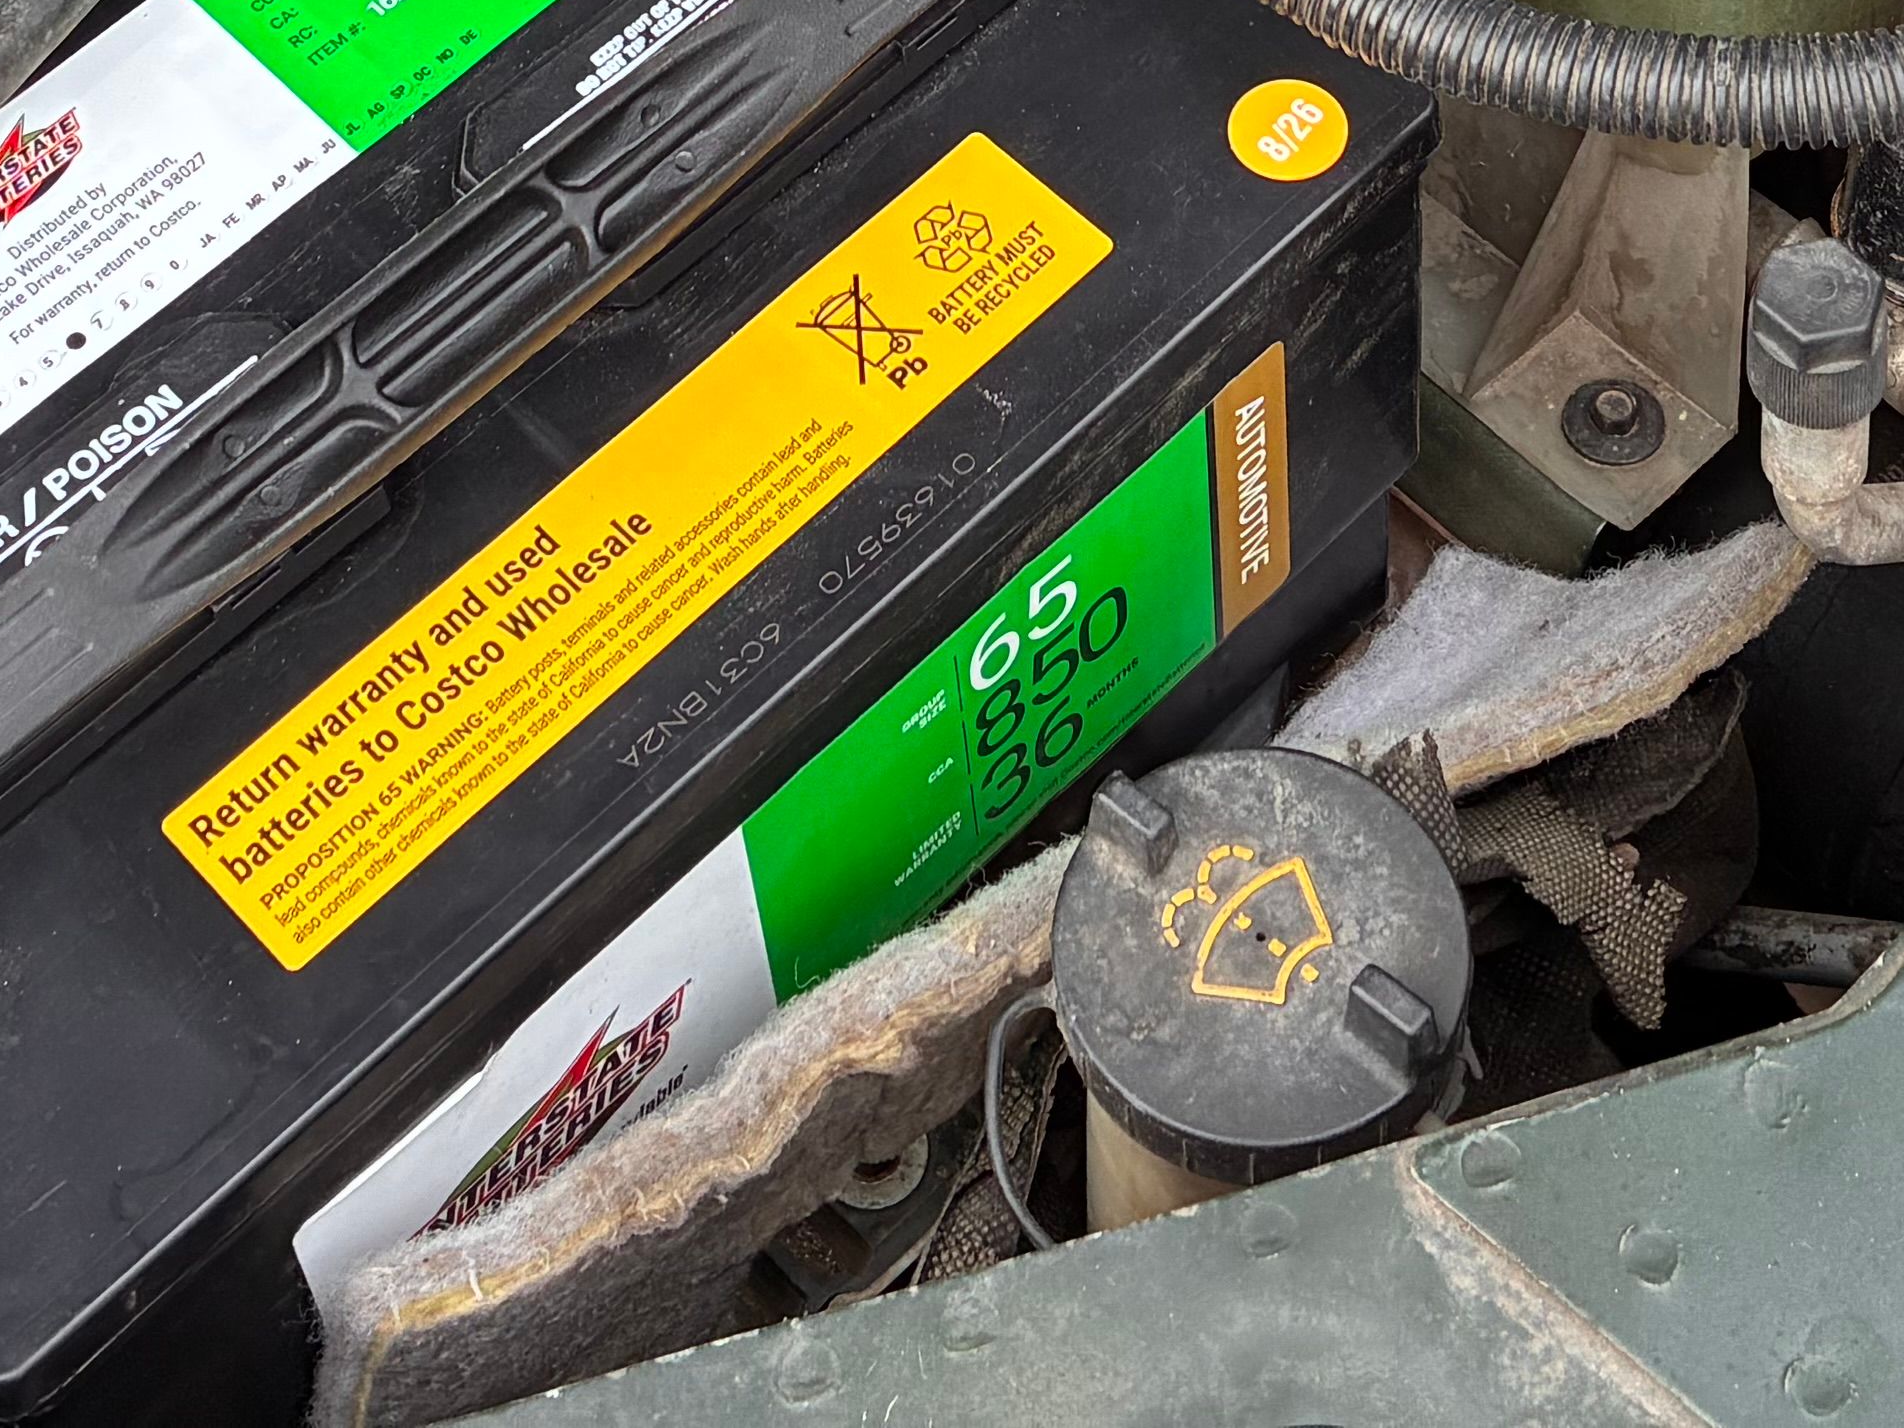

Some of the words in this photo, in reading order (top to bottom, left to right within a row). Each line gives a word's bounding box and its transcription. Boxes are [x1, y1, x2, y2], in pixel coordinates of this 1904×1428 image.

[269, 7, 299, 30] CA:
[287, 25, 318, 48] RC:
[307, 32, 349, 66] ITEM
[1257, 97, 1325, 163] 8/26
[6, 195, 88, 260] Distributed
[84, 182, 107, 201] by
[8, 323, 35, 345] For
[34, 280, 98, 326] warranty,
[94, 247, 136, 281] return
[133, 236, 151, 250] to
[148, 200, 201, 237] Costco.
[14, 220, 92, 277] Wholesale
[90, 157, 178, 221] Corporation,
[24, 264, 71, 296] Drive,
[66, 204, 140, 264] Issaquah,
[134, 189, 165, 210] WA
[161, 151, 206, 191] 98027
[927, 259, 999, 325] BATTERY
[994, 220, 1044, 267] MUST
[952, 308, 982, 335] BE
[974, 244, 1056, 316] RECYCLED
[886, 357, 928, 390] Pb
[42, 384, 185, 503] POISON
[1232, 394, 1272, 586] AUTOMOTIVE
[818, 452, 976, 595] 01639570
[259, 802, 380, 911] PROPOSITION
[378, 781, 403, 807] 65
[398, 710, 489, 786] WARNING:
[484, 675, 531, 715] Battery
[527, 648, 567, 682] posts,
[561, 601, 616, 649] terminals
[613, 578, 639, 605] and
[635, 545, 676, 586] related
[673, 494, 739, 552] accessories
[736, 460, 779, 498] contain
[772, 436, 802, 464] lead
[799, 417, 823, 443] and
[968, 554, 1079, 692] 65
[974, 585, 1129, 749] 850
[187, 753, 301, 848] Return
[296, 640, 430, 756] warranty
[428, 585, 489, 646] and
[484, 524, 561, 597] used
[218, 760, 364, 885] batteries
[358, 729, 399, 762] to
[395, 640, 505, 730] Costco
[496, 513, 652, 642] Wholesale
[901, 688, 946, 733] GROUP
[913, 696, 947, 729] SIZE
[927, 757, 954, 784] CCA
[980, 696, 1085, 821] 36
[422, 993, 682, 1237] NTERSTATE
